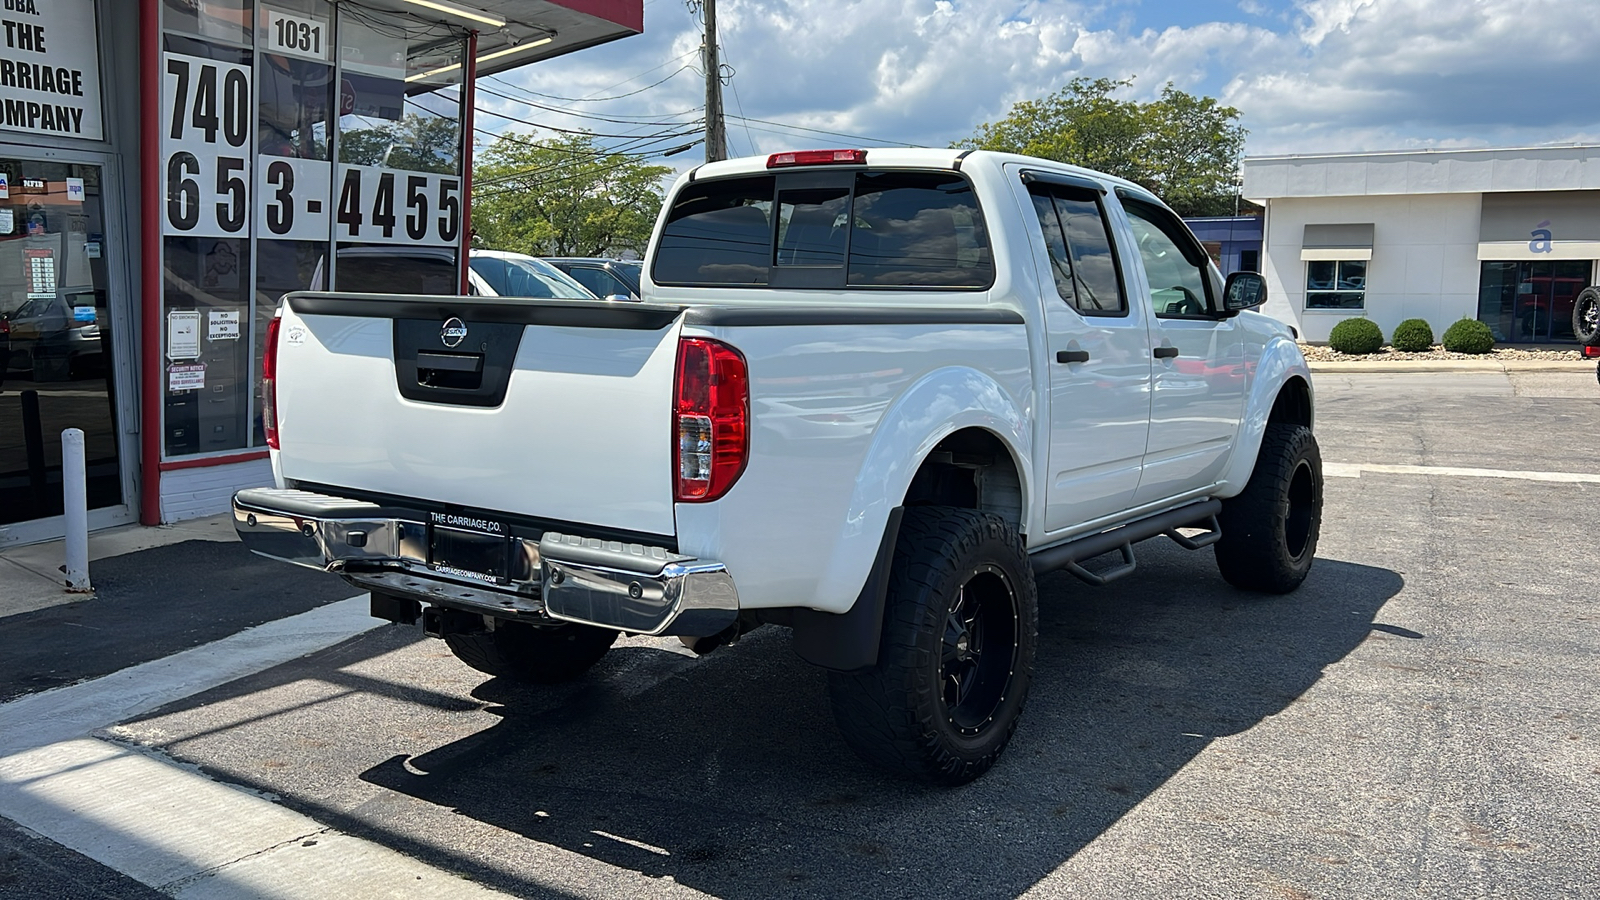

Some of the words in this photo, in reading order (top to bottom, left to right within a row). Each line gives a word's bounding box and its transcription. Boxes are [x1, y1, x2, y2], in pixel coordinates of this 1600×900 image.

[2, 19, 46, 54] THE
[274, 17, 321, 54] 1031
[0, 58, 84, 97] RRIAGE
[167, 58, 248, 148] 740
[430, 512, 446, 523] THE
[447, 514, 487, 529] CARRIAGE
[488, 521, 502, 532] CO.
[435, 566, 496, 583] CARRIAGECOMPANY.COM
